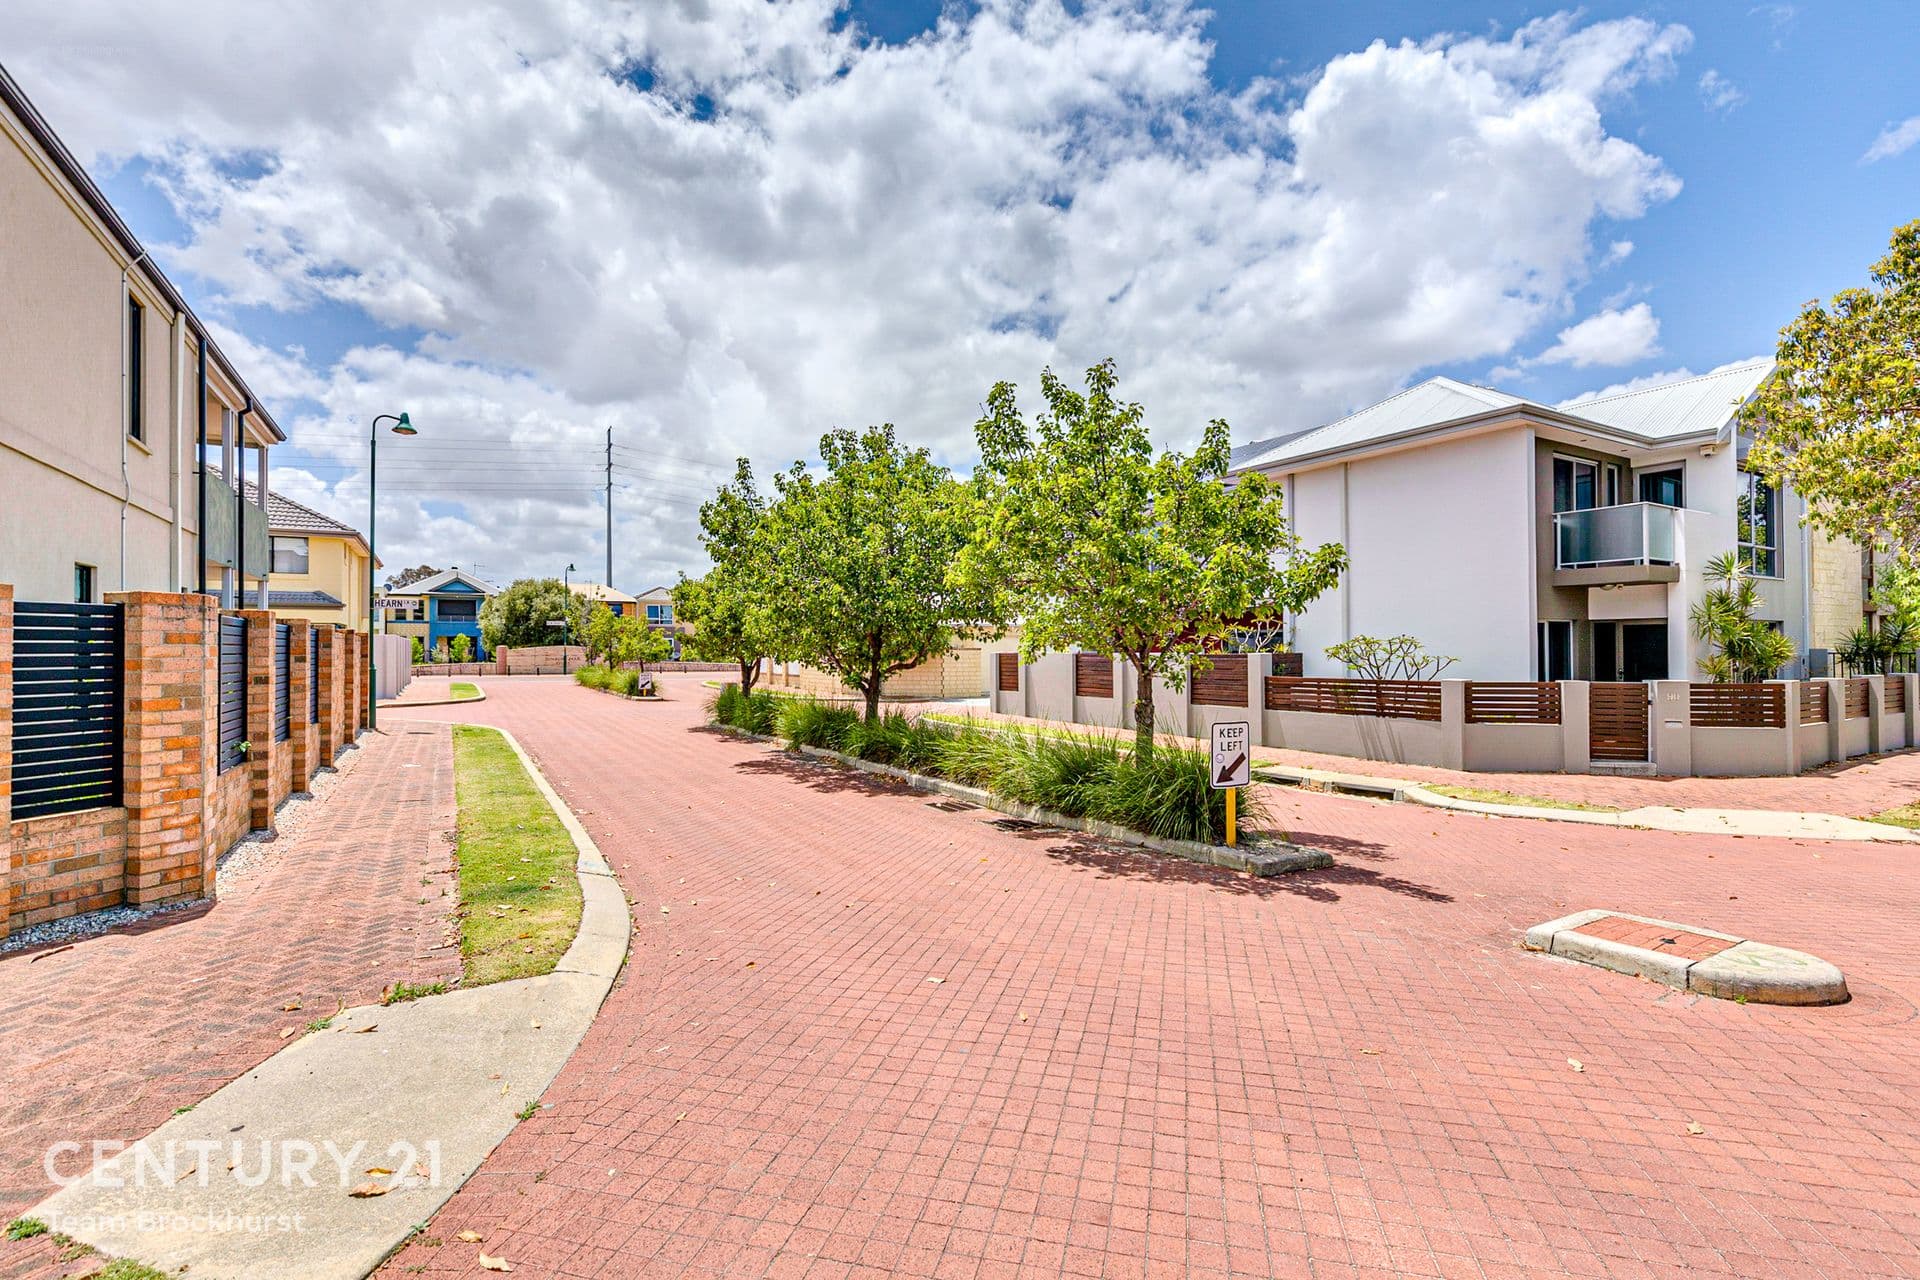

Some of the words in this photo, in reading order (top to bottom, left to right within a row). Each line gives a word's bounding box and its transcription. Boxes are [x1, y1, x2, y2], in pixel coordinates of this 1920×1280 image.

[375, 599, 403, 608] HEARN
[1219, 727, 1244, 738] KEEP
[1220, 740, 1243, 751] LEFT
